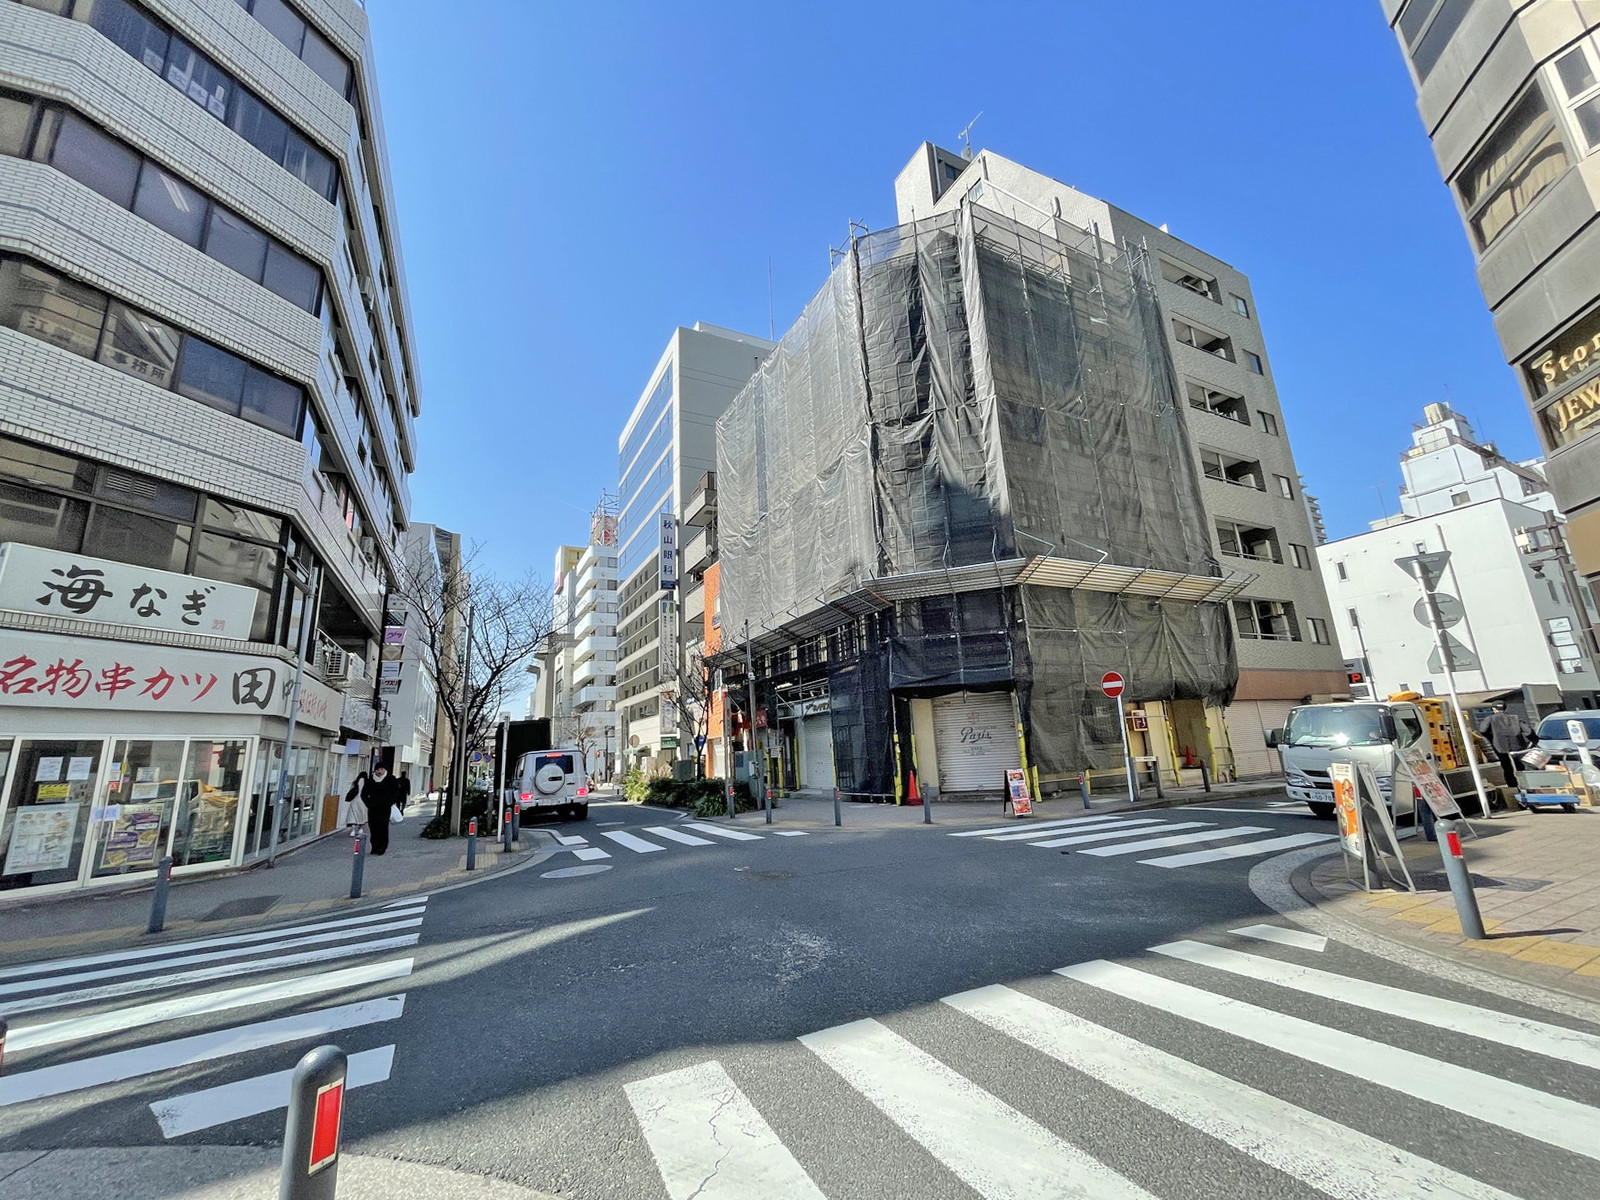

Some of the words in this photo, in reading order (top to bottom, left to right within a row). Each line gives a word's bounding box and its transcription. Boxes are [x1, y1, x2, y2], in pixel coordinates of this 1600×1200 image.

[663, 520, 673, 575] 秋山眼科
[36, 564, 217, 626] 海なぎ
[1351, 673, 1361, 683] P
[960, 726, 992, 743] Paris
